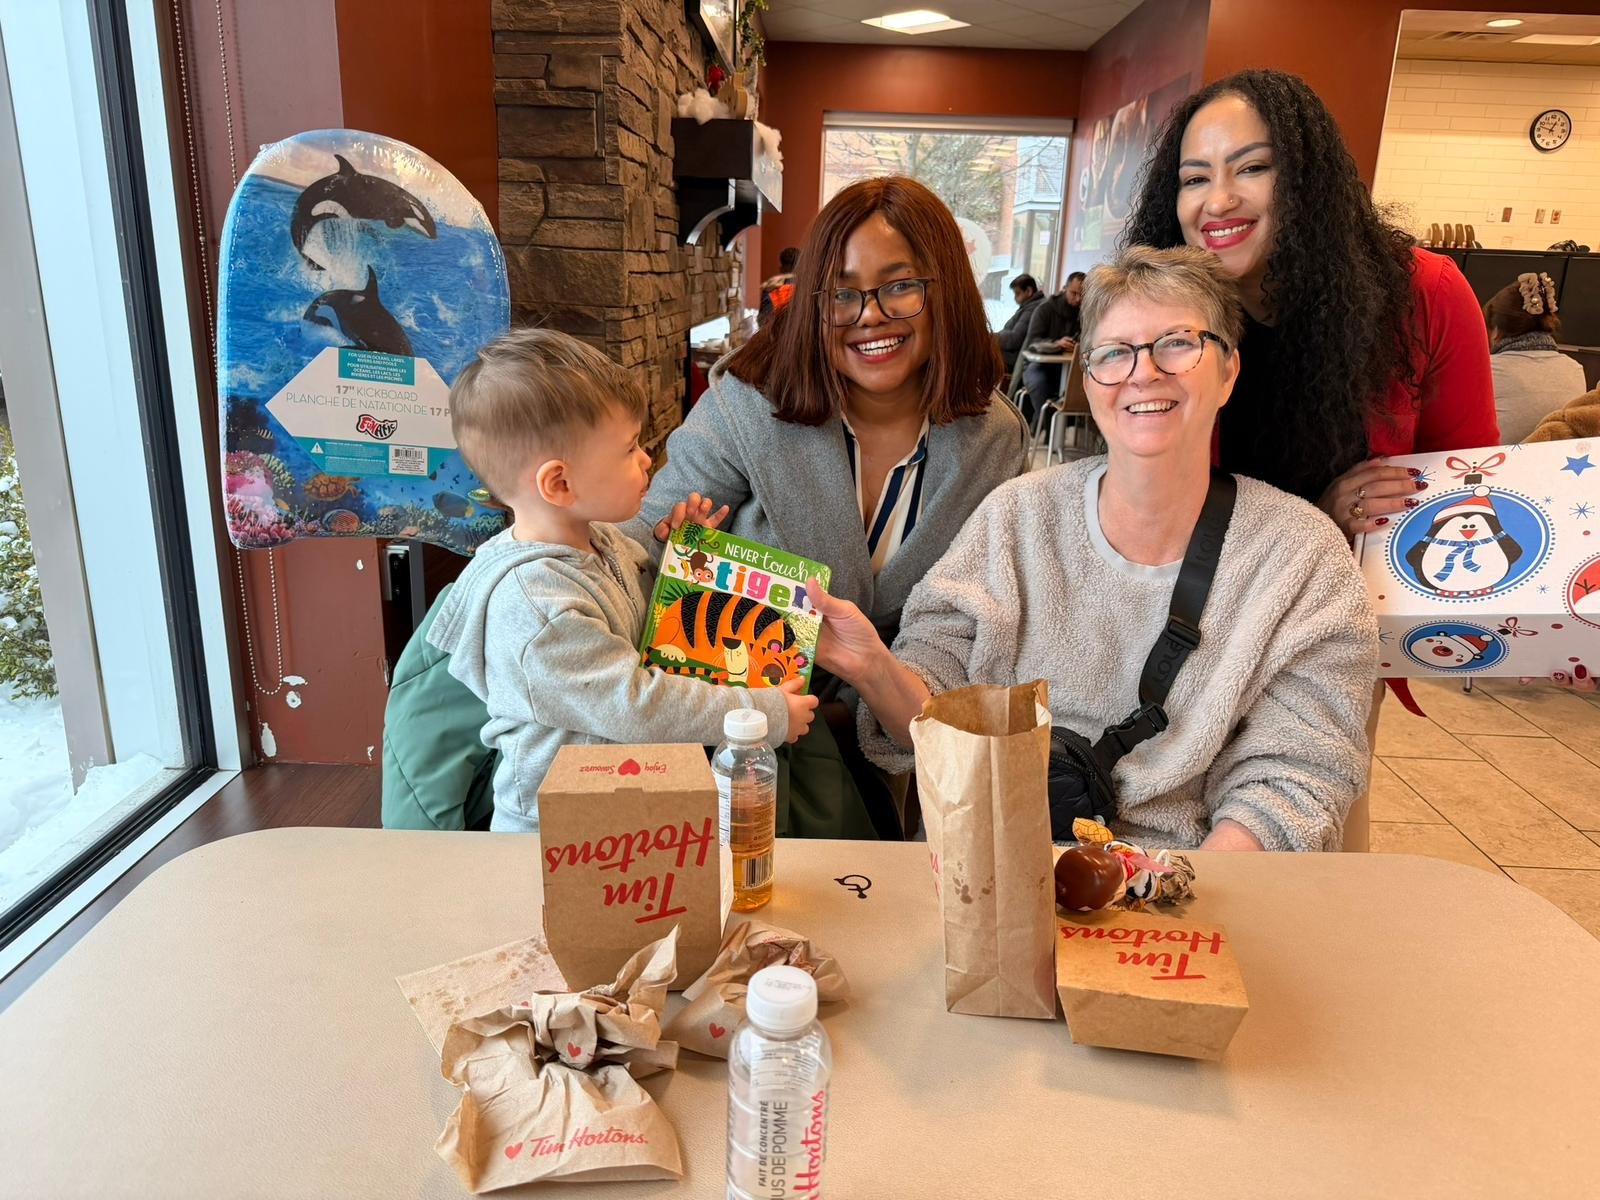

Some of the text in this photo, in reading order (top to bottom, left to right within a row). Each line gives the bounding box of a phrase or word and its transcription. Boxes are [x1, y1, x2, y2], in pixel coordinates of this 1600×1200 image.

[286, 392, 340, 407] PLANCHE
[342, 398, 357, 408] DE
[359, 399, 412, 414] NATATION
[413, 404, 428, 416] DE
[430, 407, 442, 416] 17
[356, 386, 418, 402] KICKBOARD
[724, 541, 760, 564] NEVER
[759, 551, 811, 582] touch
[579, 761, 667, 775] Enjoy Savourez
[544, 817, 715, 873] Hortons
[602, 872, 688, 924] Tim
[1060, 925, 1226, 955] Hortons
[1117, 951, 1207, 981] Tim
[771, 1101, 788, 1155] POMME
[793, 1090, 825, 1192] Hortons
[529, 1134, 566, 1158] Tim
[759, 1155, 769, 1167] DE
[771, 1156, 787, 1176] DE
[758, 1168, 769, 1187] FAIT
